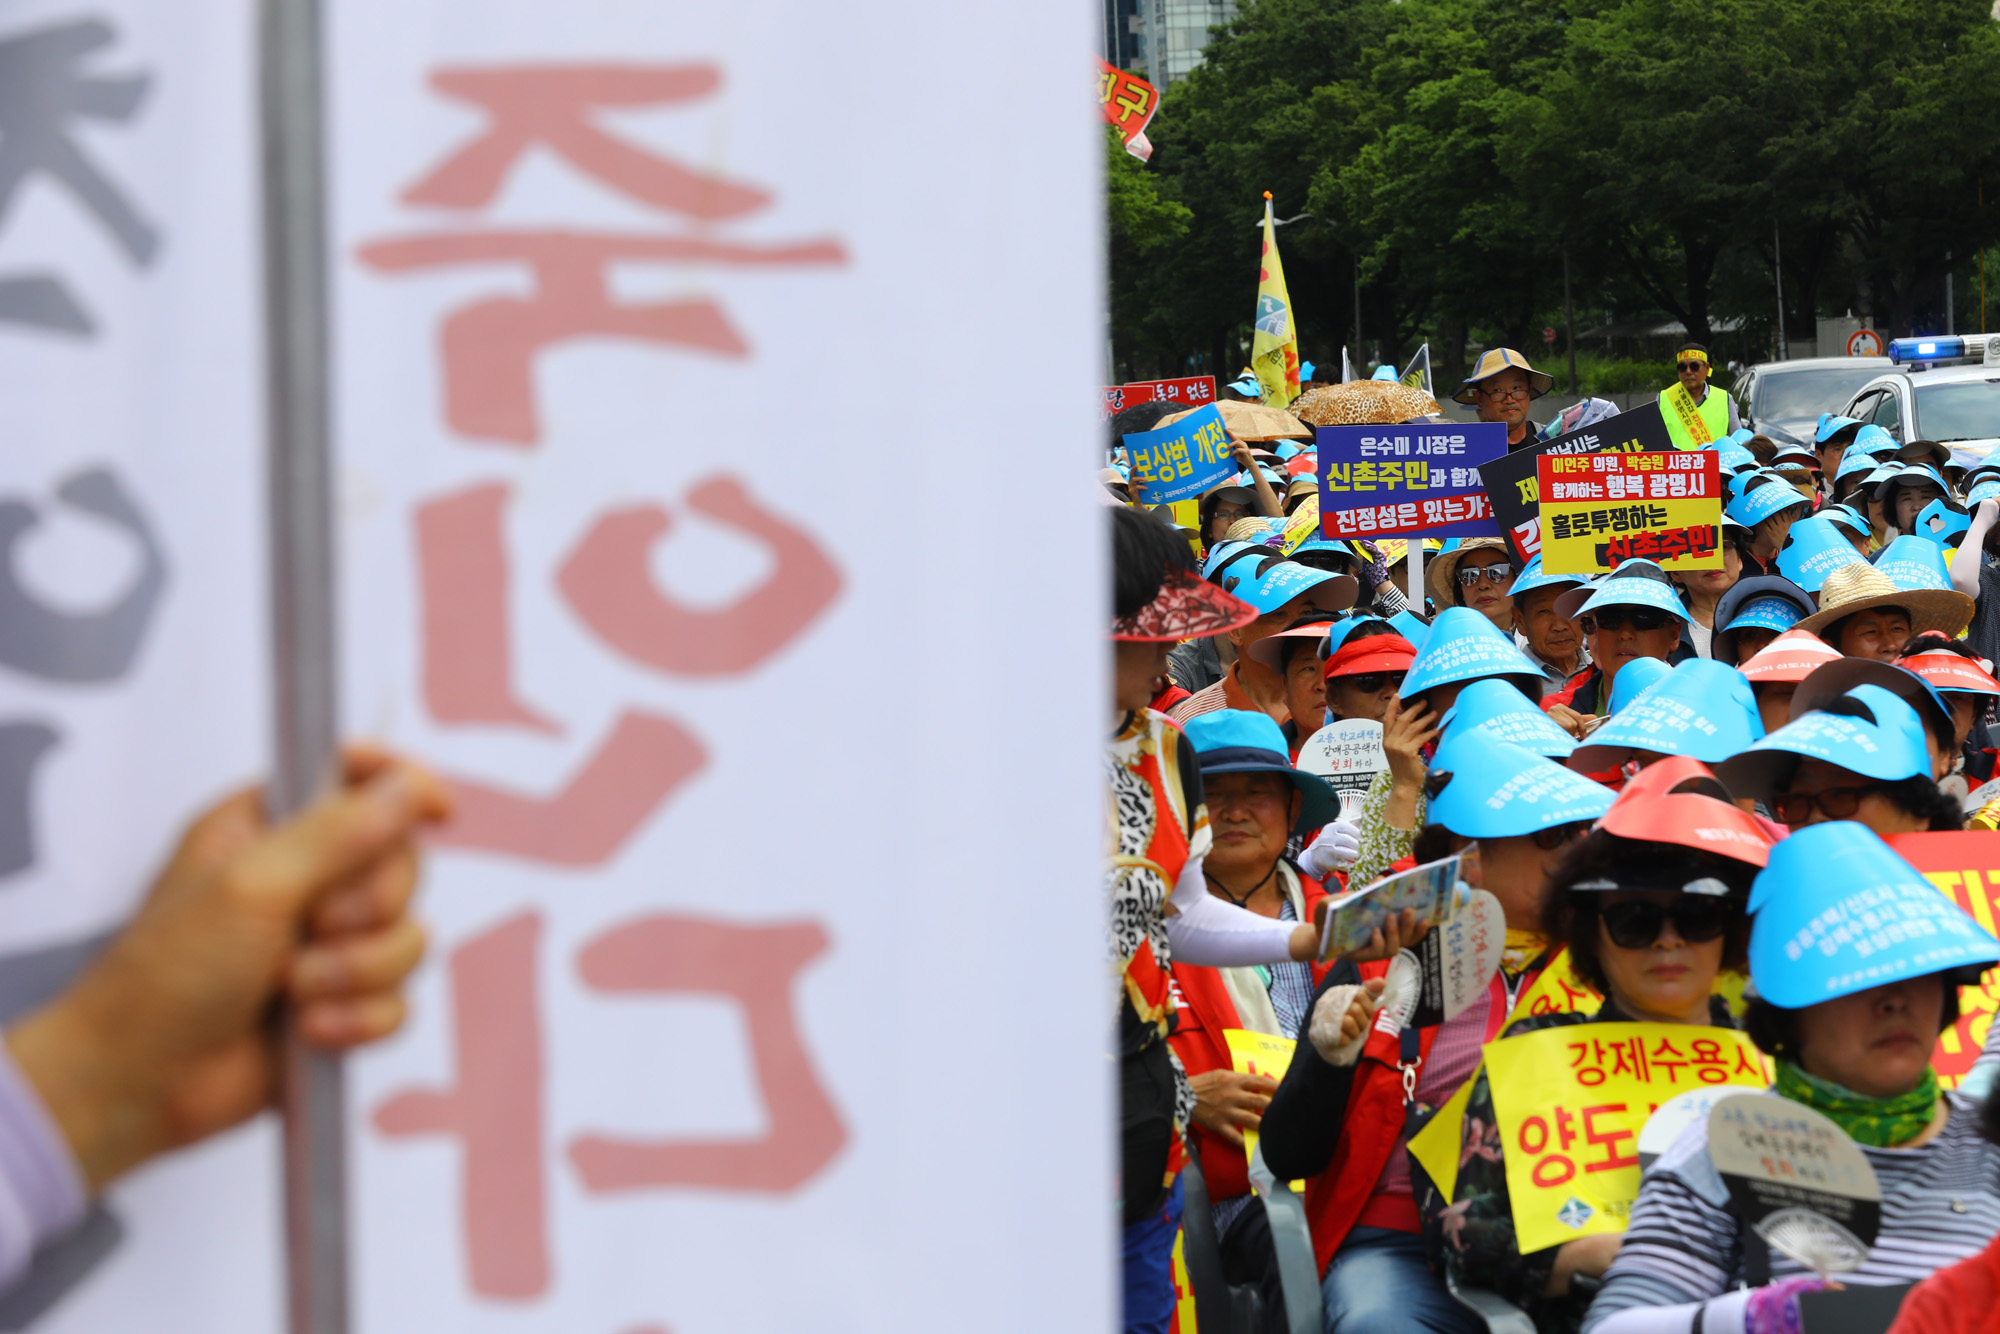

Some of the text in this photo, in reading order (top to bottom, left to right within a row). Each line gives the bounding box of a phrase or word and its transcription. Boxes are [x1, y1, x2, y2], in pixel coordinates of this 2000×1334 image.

[1187, 381, 1210, 400] 없는
[1133, 418, 1230, 483] 보상법 개정
[1360, 435, 1466, 456] 은수미 시장은
[1326, 461, 1447, 492] 신촌주민과
[1552, 457, 1590, 473] 이언주
[1593, 456, 1624, 474] 의원,
[1626, 455, 1664, 471] 박승원
[1668, 454, 1705, 470] 시장과
[1552, 482, 1603, 499] 함께하는
[1606, 474, 1645, 498] 행복
[1649, 472, 1705, 497] 광명시
[1336, 502, 1418, 533] 진정성은
[1552, 504, 1668, 539] 홀로투쟁하는
[1605, 524, 1714, 569] 신촌주민
[1919, 667, 1950, 675] 신도시
[1519, 1104, 1657, 1188] 양도
